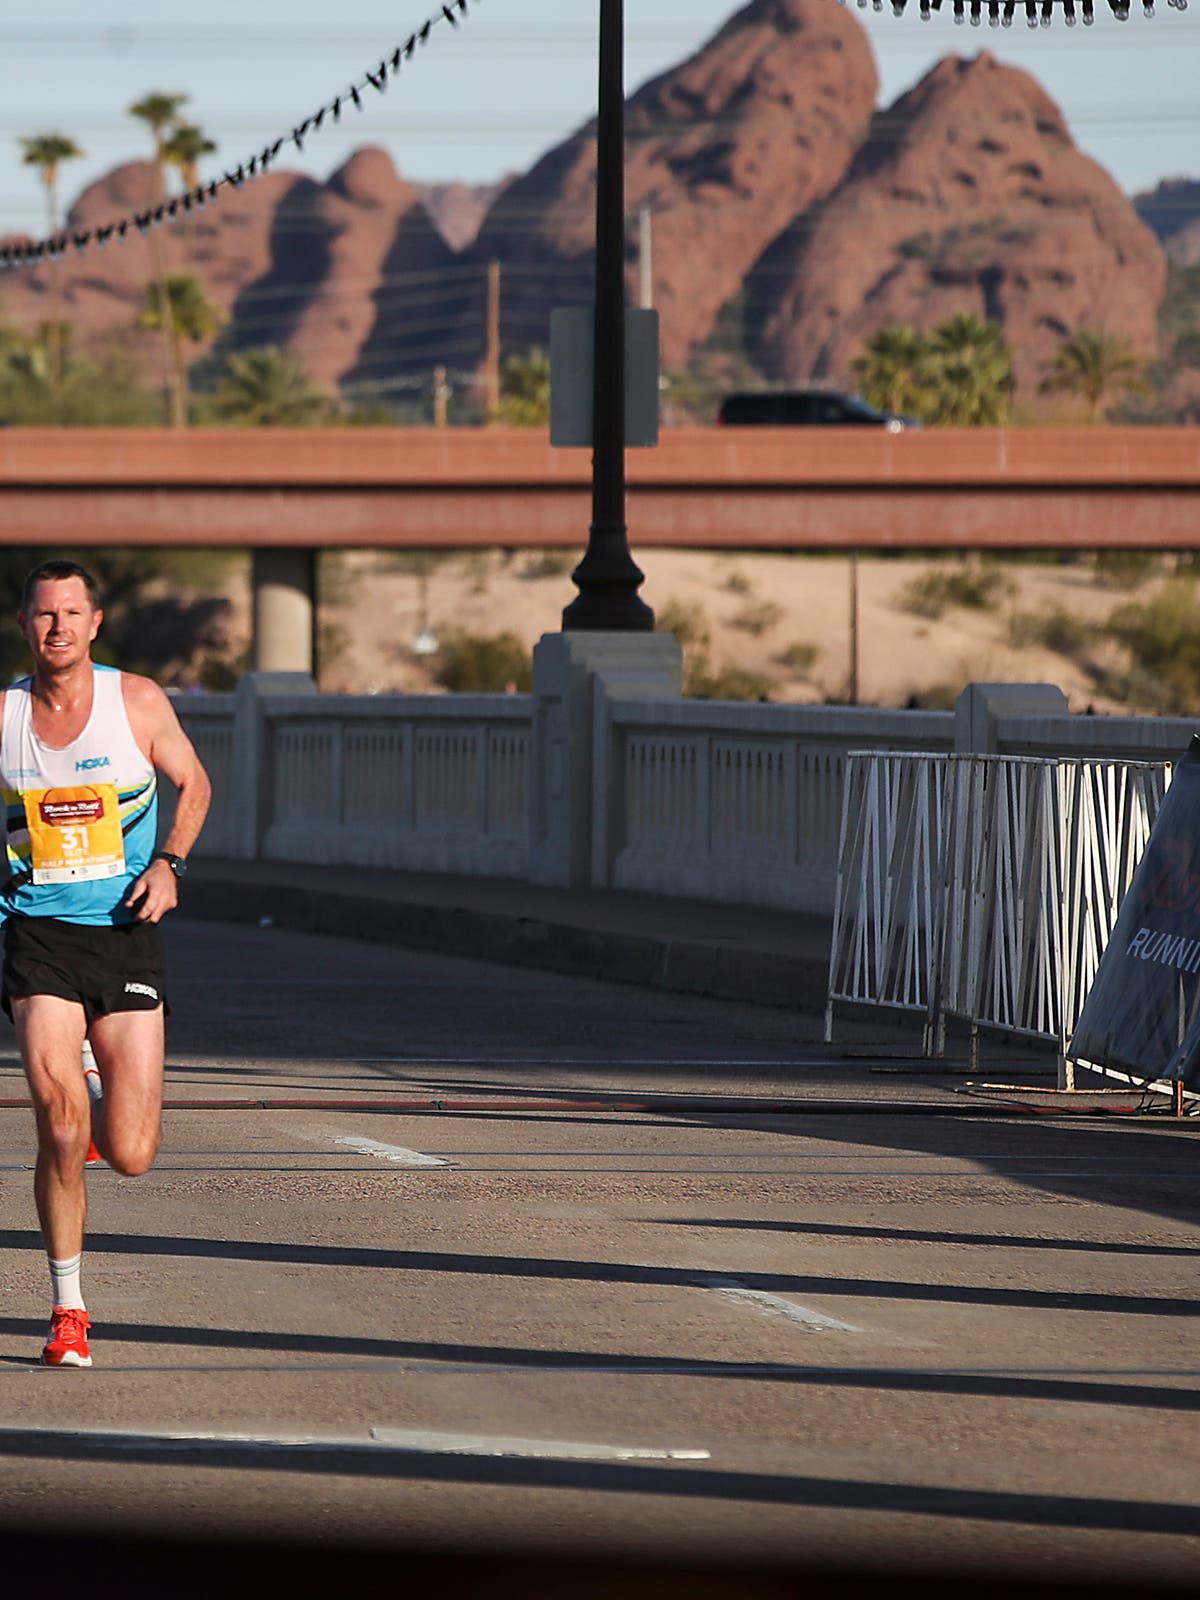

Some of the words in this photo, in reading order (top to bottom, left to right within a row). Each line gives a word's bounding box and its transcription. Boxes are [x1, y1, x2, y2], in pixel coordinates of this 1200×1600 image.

[75, 756, 111, 771] HOKA
[60, 827, 89, 850] 31
[1126, 927, 1200, 973] RUNNI
